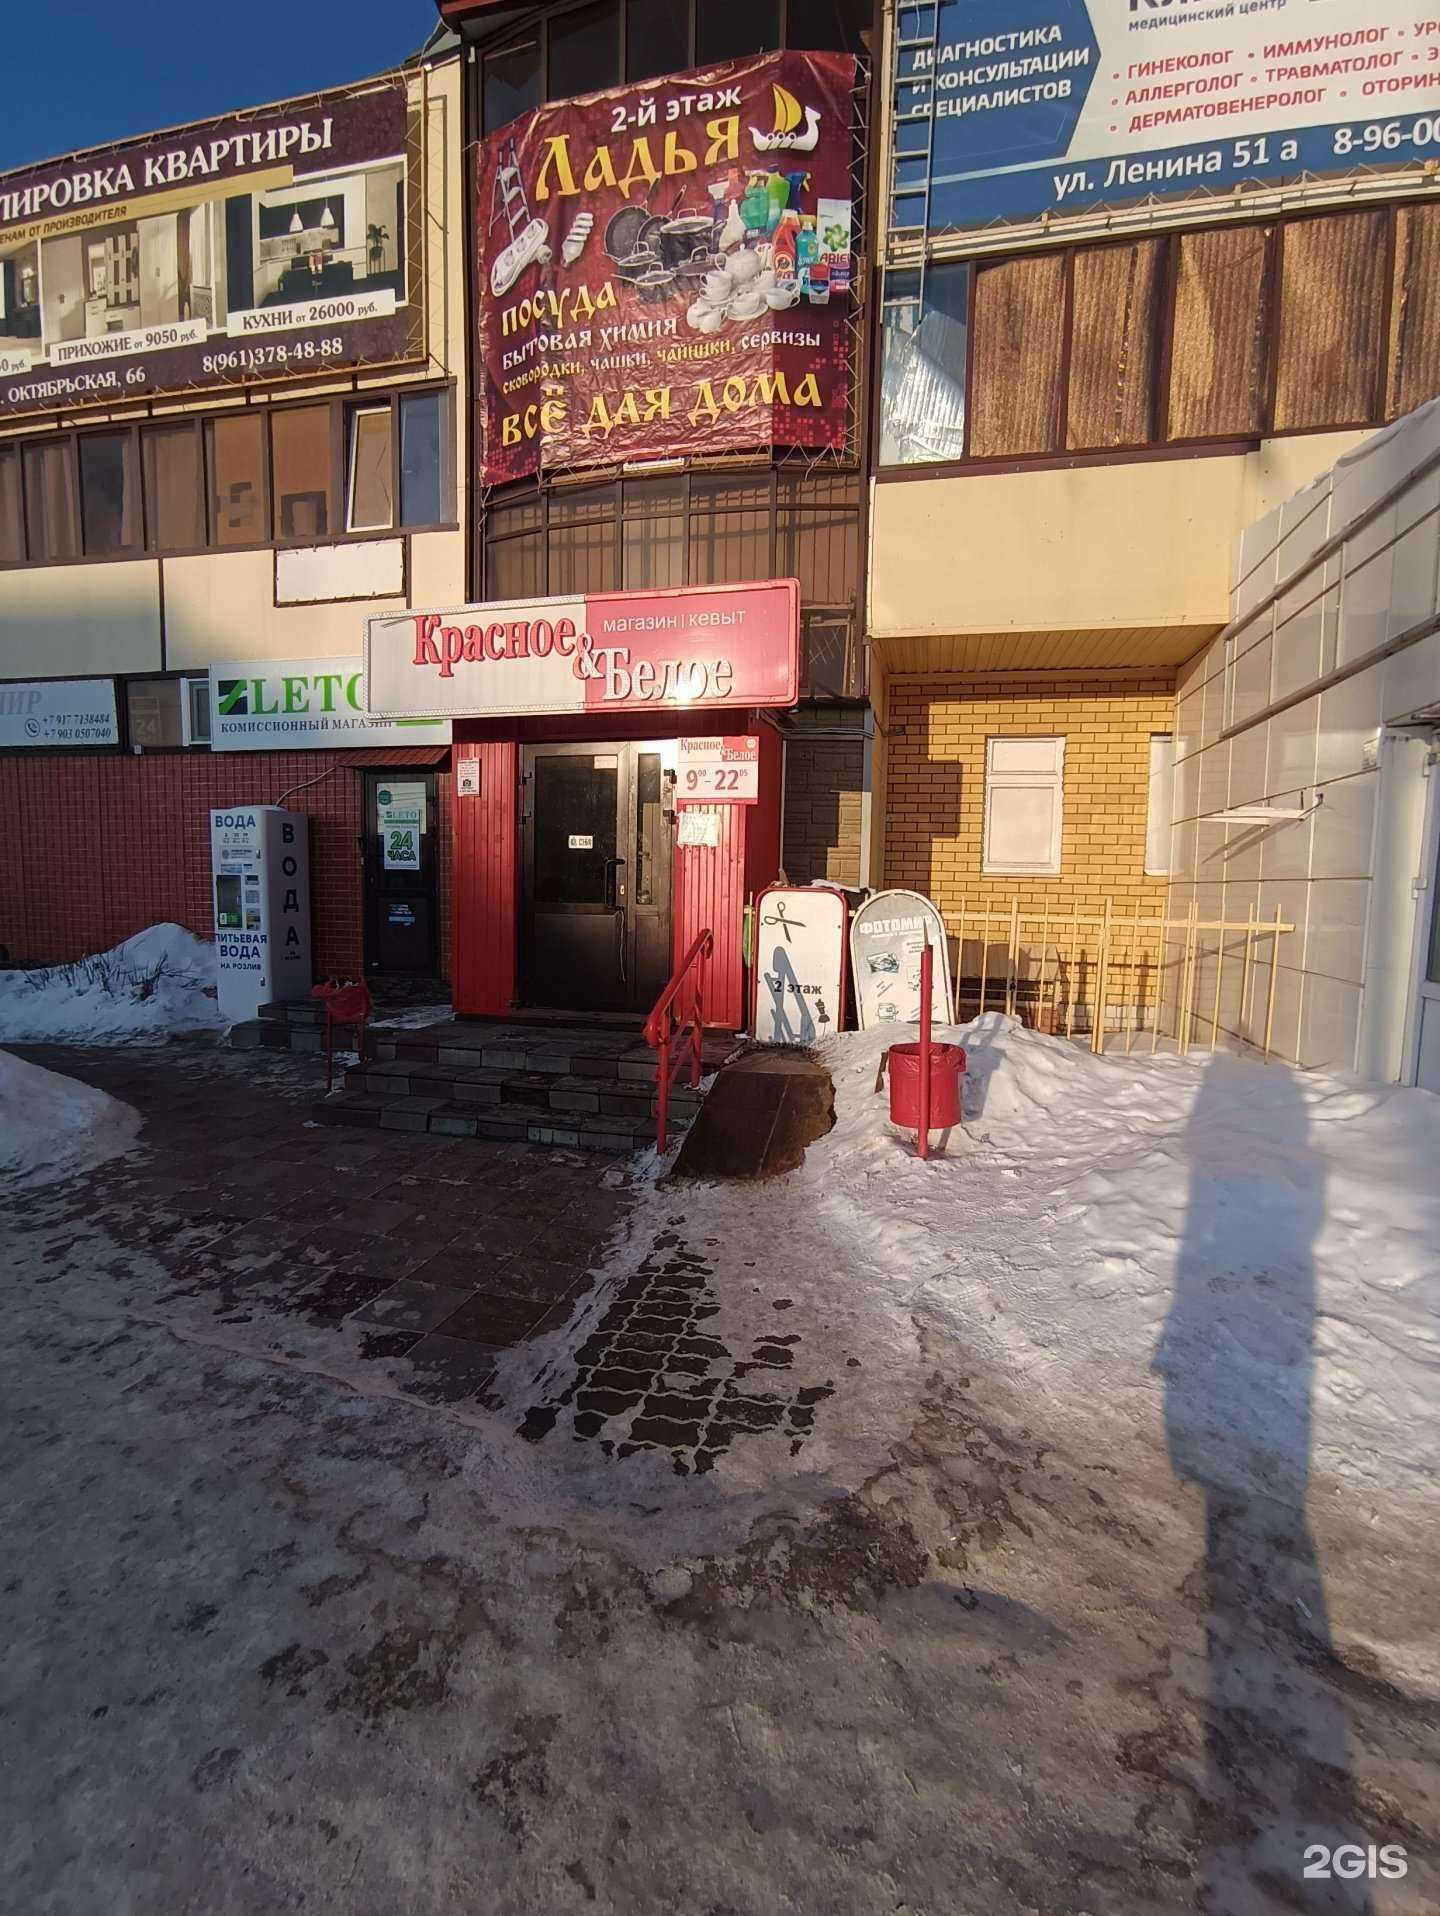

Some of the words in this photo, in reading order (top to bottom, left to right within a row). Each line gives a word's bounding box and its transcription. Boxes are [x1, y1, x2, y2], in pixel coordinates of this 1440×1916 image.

[1129, 8, 1234, 32] медицинский
[1128, 50, 1234, 79] ГИНЕКОЛОГ
[1263, 27, 1390, 59] ИММУНОЛОГ
[1414, 21, 1440, 37] УР
[935, 48, 1090, 91] КОНСУЛЬТАЦИИ
[1126, 73, 1244, 105] АЛЛЕРГОЛОГ
[1266, 51, 1404, 83] ТРАВМАТОЛОГ
[1129, 88, 1327, 133] ДЕРМАТОВЕНЕРОЛОГ
[144, 118, 334, 187] КВАРТИРЫ
[535, 115, 740, 201] Ладья
[1053, 171, 1094, 201] ул.
[1104, 150, 1222, 188] Ленина
[1233, 137, 1270, 168] 51
[29, 225, 41, 236] ОТ
[43, 206, 127, 232] ПРОИЗВОДИТЕЛЯ
[243, 310, 293, 330] КУХНИ
[296, 315, 306, 323] от
[309, 302, 355, 321] 26000
[357, 302, 378, 316] руб.
[58, 337, 132, 361] ПРИХОЖИЕ
[134, 340, 143, 348] от
[145, 329, 178, 347] 9050
[203, 337, 343, 373] 8(961)378-48-88
[8, 370, 121, 403] ОКТЯБРЬСКАЯ,
[126, 366, 146, 385] 66
[603, 616, 677, 633] магазин
[689, 610, 746, 626] кевыт
[412, 614, 576, 678] Красное
[573, 632, 605, 681] &
[592, 647, 733, 702] Белое
[57, 728, 72, 740] 903
[221, 716, 329, 733] КОМИССИОННЫЙ
[215, 815, 256, 829] ВОДА
[390, 830, 413, 850] 24
[387, 850, 417, 861] ЧАСА
[220, 945, 261, 960] ВОДА
[232, 962, 262, 970] РОЗЛИВ
[774, 980, 782, 993] 2
[787, 983, 822, 995] этаж
